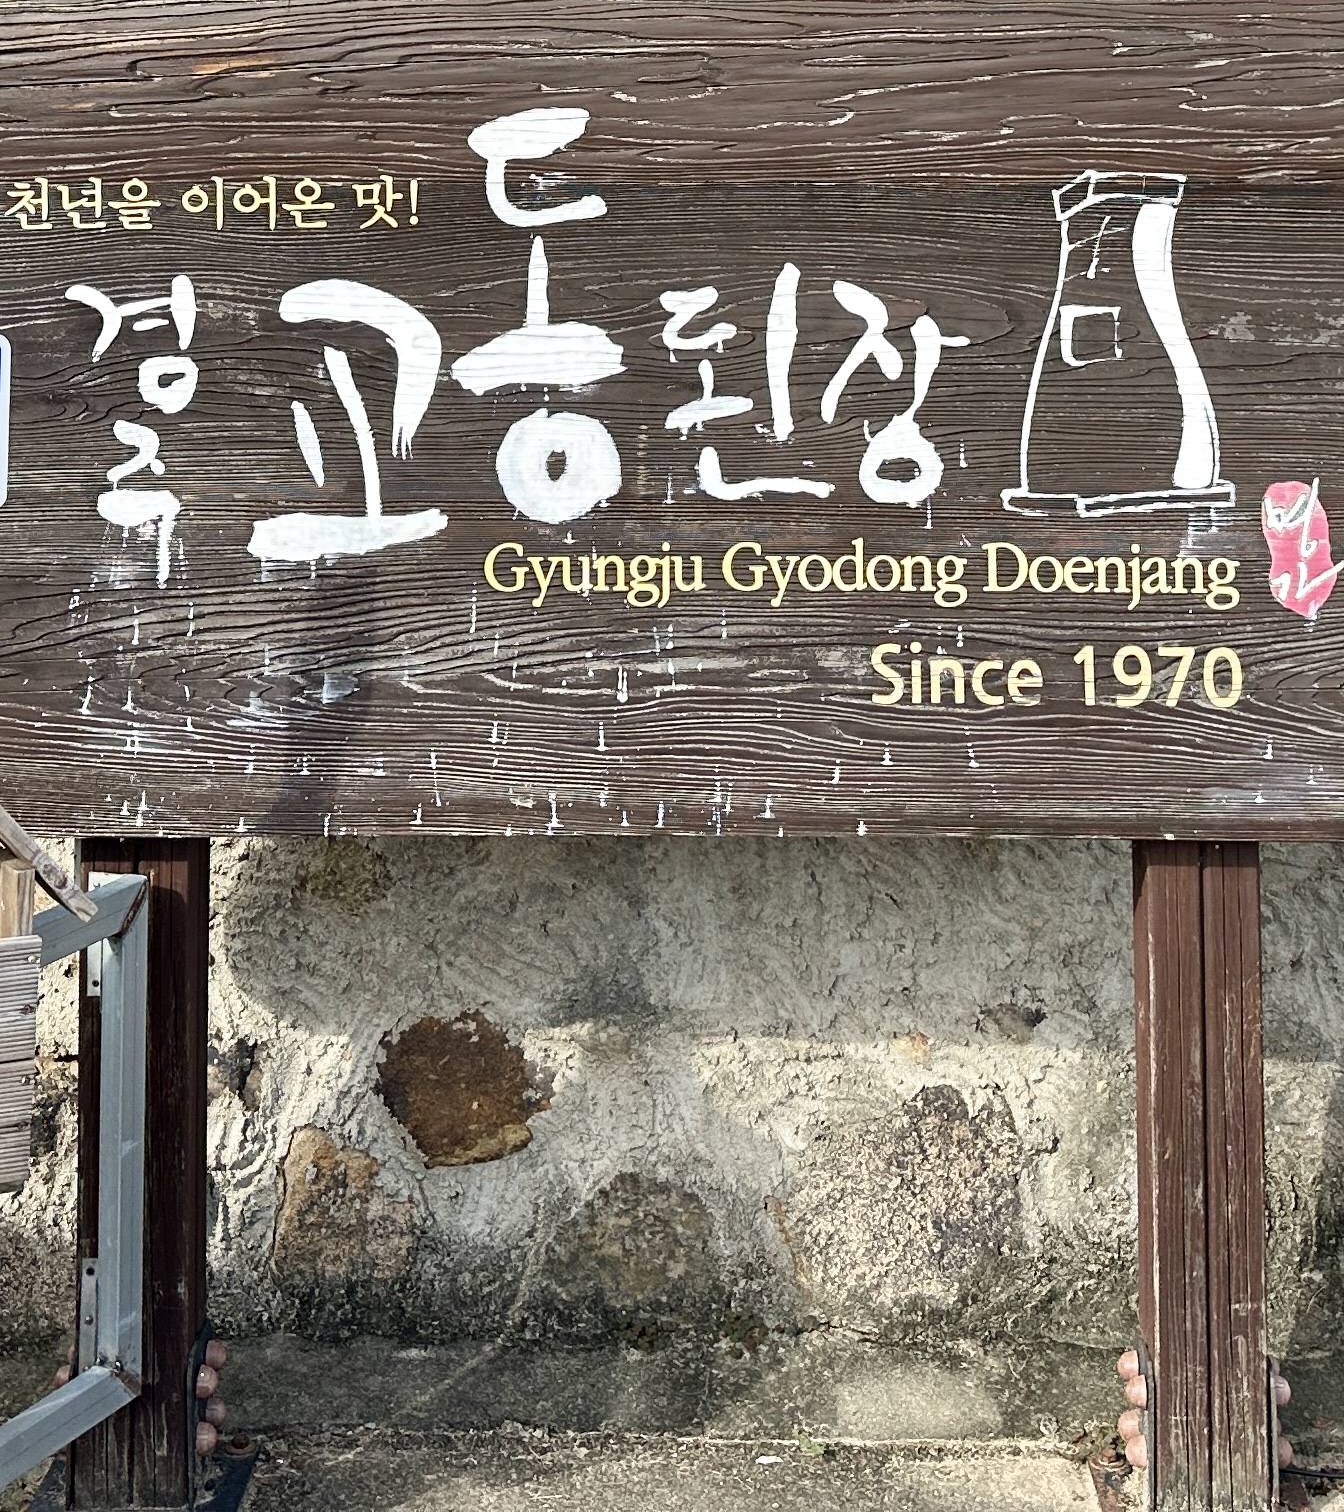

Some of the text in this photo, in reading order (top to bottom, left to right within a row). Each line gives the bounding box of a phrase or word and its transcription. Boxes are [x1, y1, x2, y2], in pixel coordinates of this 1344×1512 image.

[4, 176, 420, 230] 천년을 이어온 맛!
[483, 538, 1241, 610] Gyungju Gyodong Doenjang
[870, 641, 1244, 709] Since 1970
